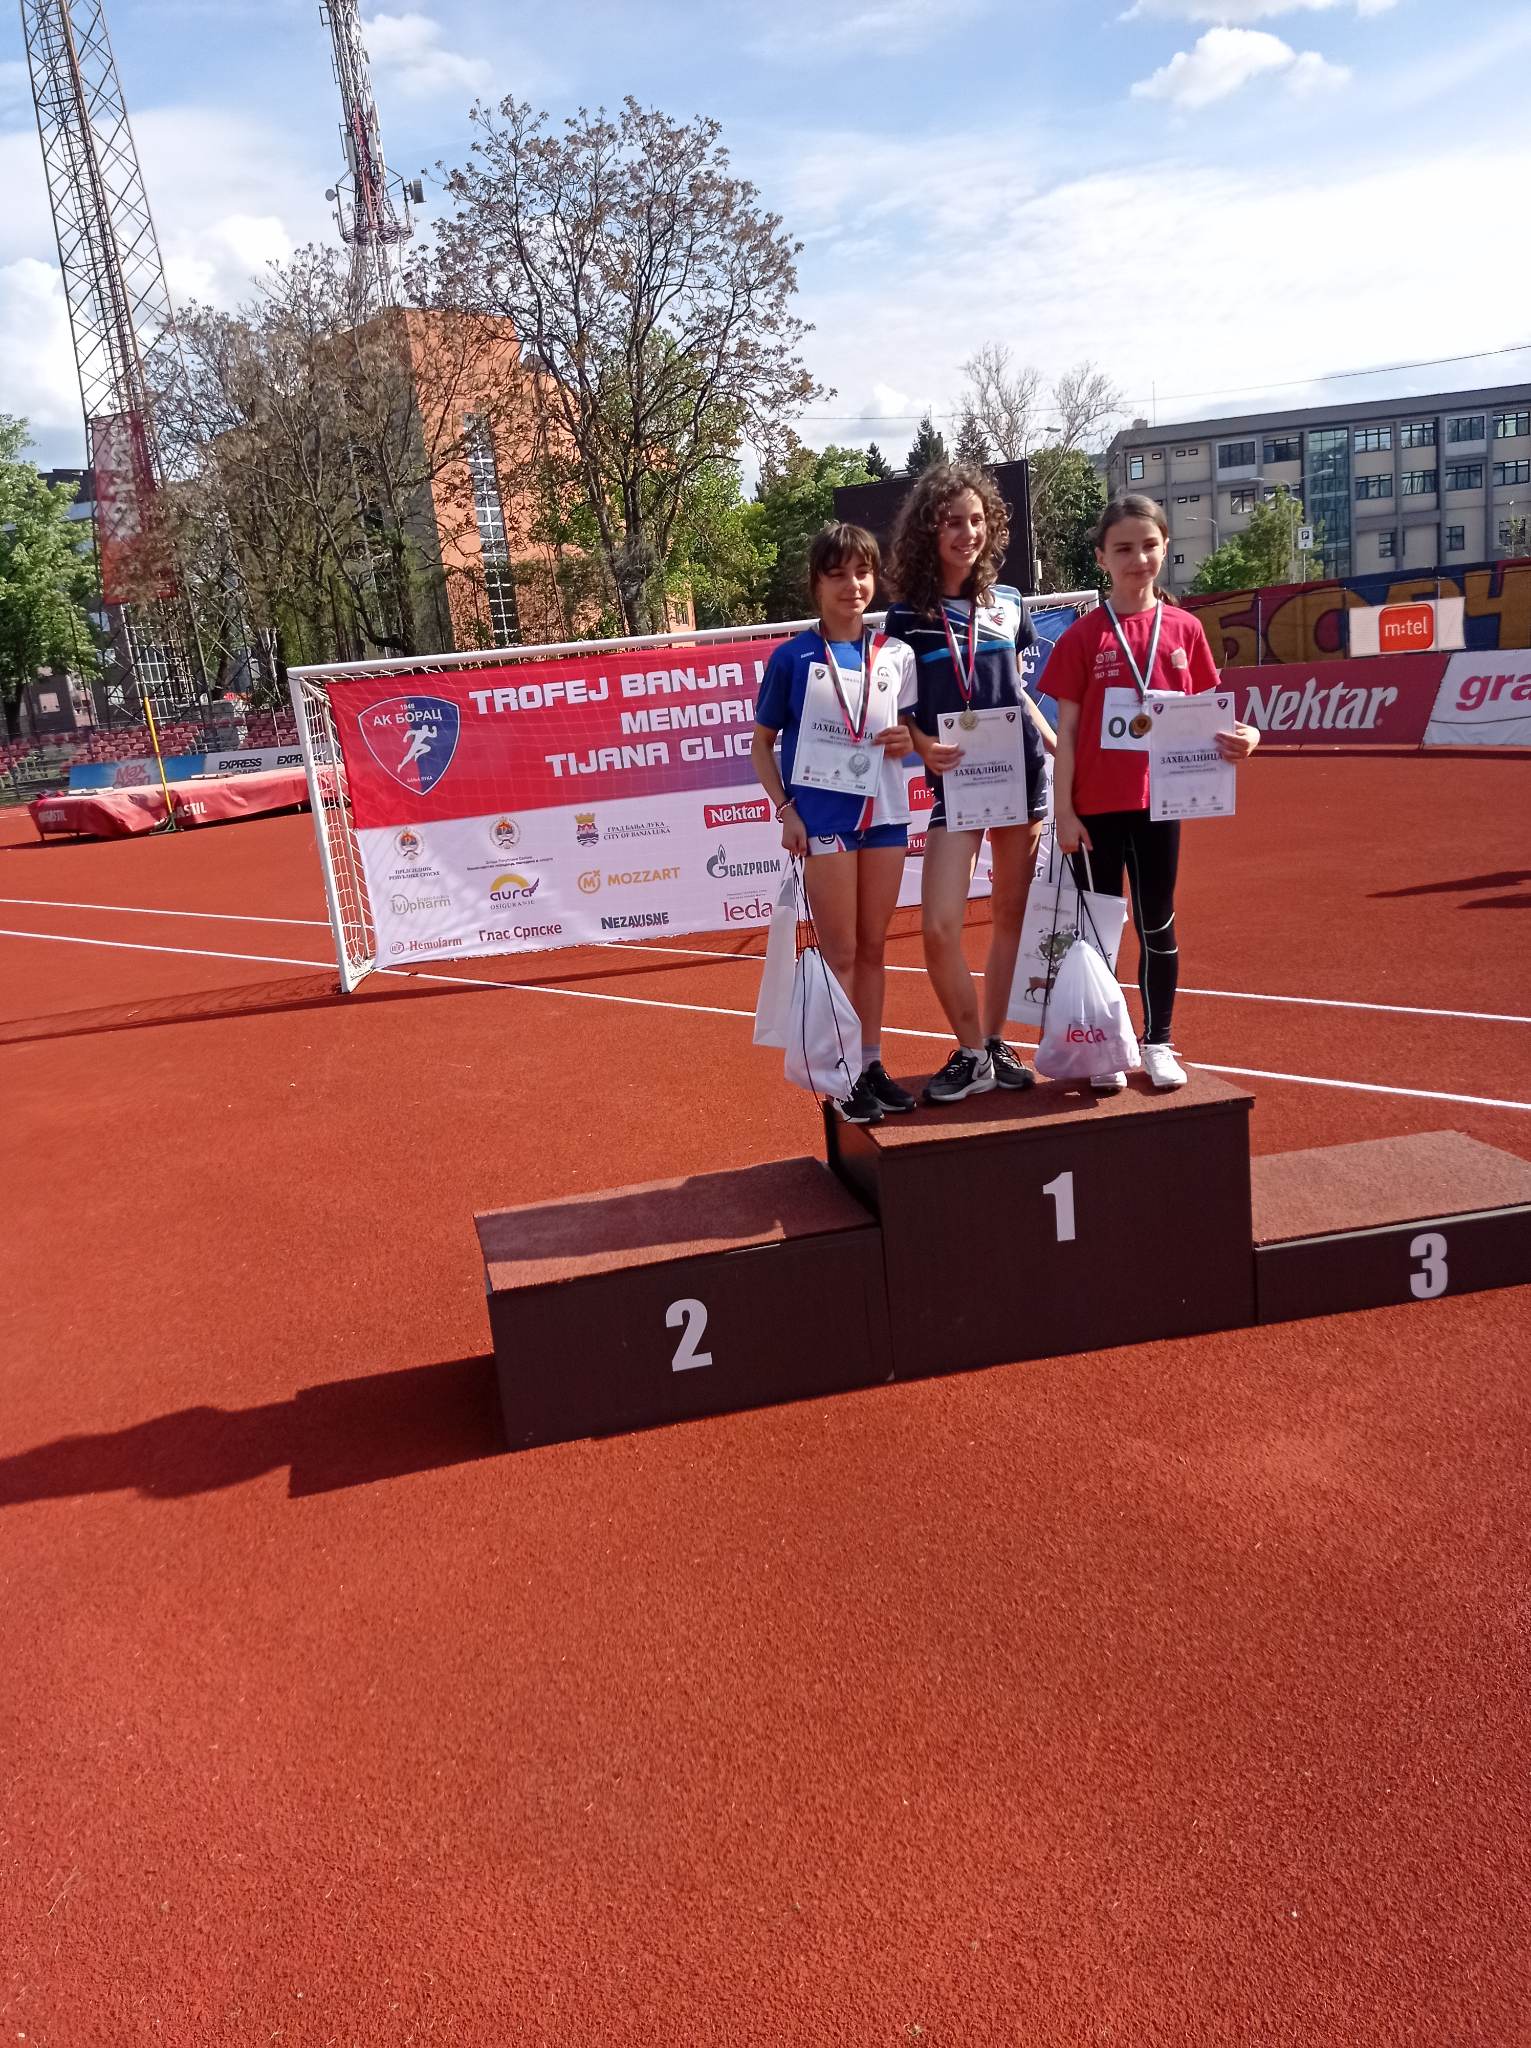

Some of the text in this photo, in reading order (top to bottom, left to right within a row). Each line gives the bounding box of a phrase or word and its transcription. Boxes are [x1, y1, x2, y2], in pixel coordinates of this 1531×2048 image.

[1385, 616, 1428, 638] m:tel
[468, 677, 609, 715] TROFEJ
[620, 662, 743, 698] BANJA
[1456, 674, 1531, 711] gra
[1242, 677, 1398, 730] Nektar
[373, 709, 442, 726] АК БОРАЦ
[621, 698, 754, 735] MEMORI
[811, 722, 873, 739] ЗАХВАЛЦА
[219, 754, 303, 770] EXPRESS EXPR
[545, 731, 754, 777] TIJANA GLIG
[1160, 751, 1223, 765] ЗАХВАЛНИЦА
[953, 764, 1014, 777] ЗАХВАЛНИЦА
[710, 804, 766, 824] Nektar
[607, 867, 680, 886] MOZZART
[729, 859, 781, 877] GAZPROM
[490, 887, 534, 902] aura
[723, 898, 773, 922] leda
[600, 912, 670, 929] NEZAVISNE
[479, 923, 562, 942] Глас Српске
[410, 937, 462, 952] Hemofarm
[1066, 1023, 1107, 1043] leda
[1043, 1171, 1075, 1241] 1
[1410, 1233, 1449, 1298] 3
[666, 1298, 712, 1371] 2
